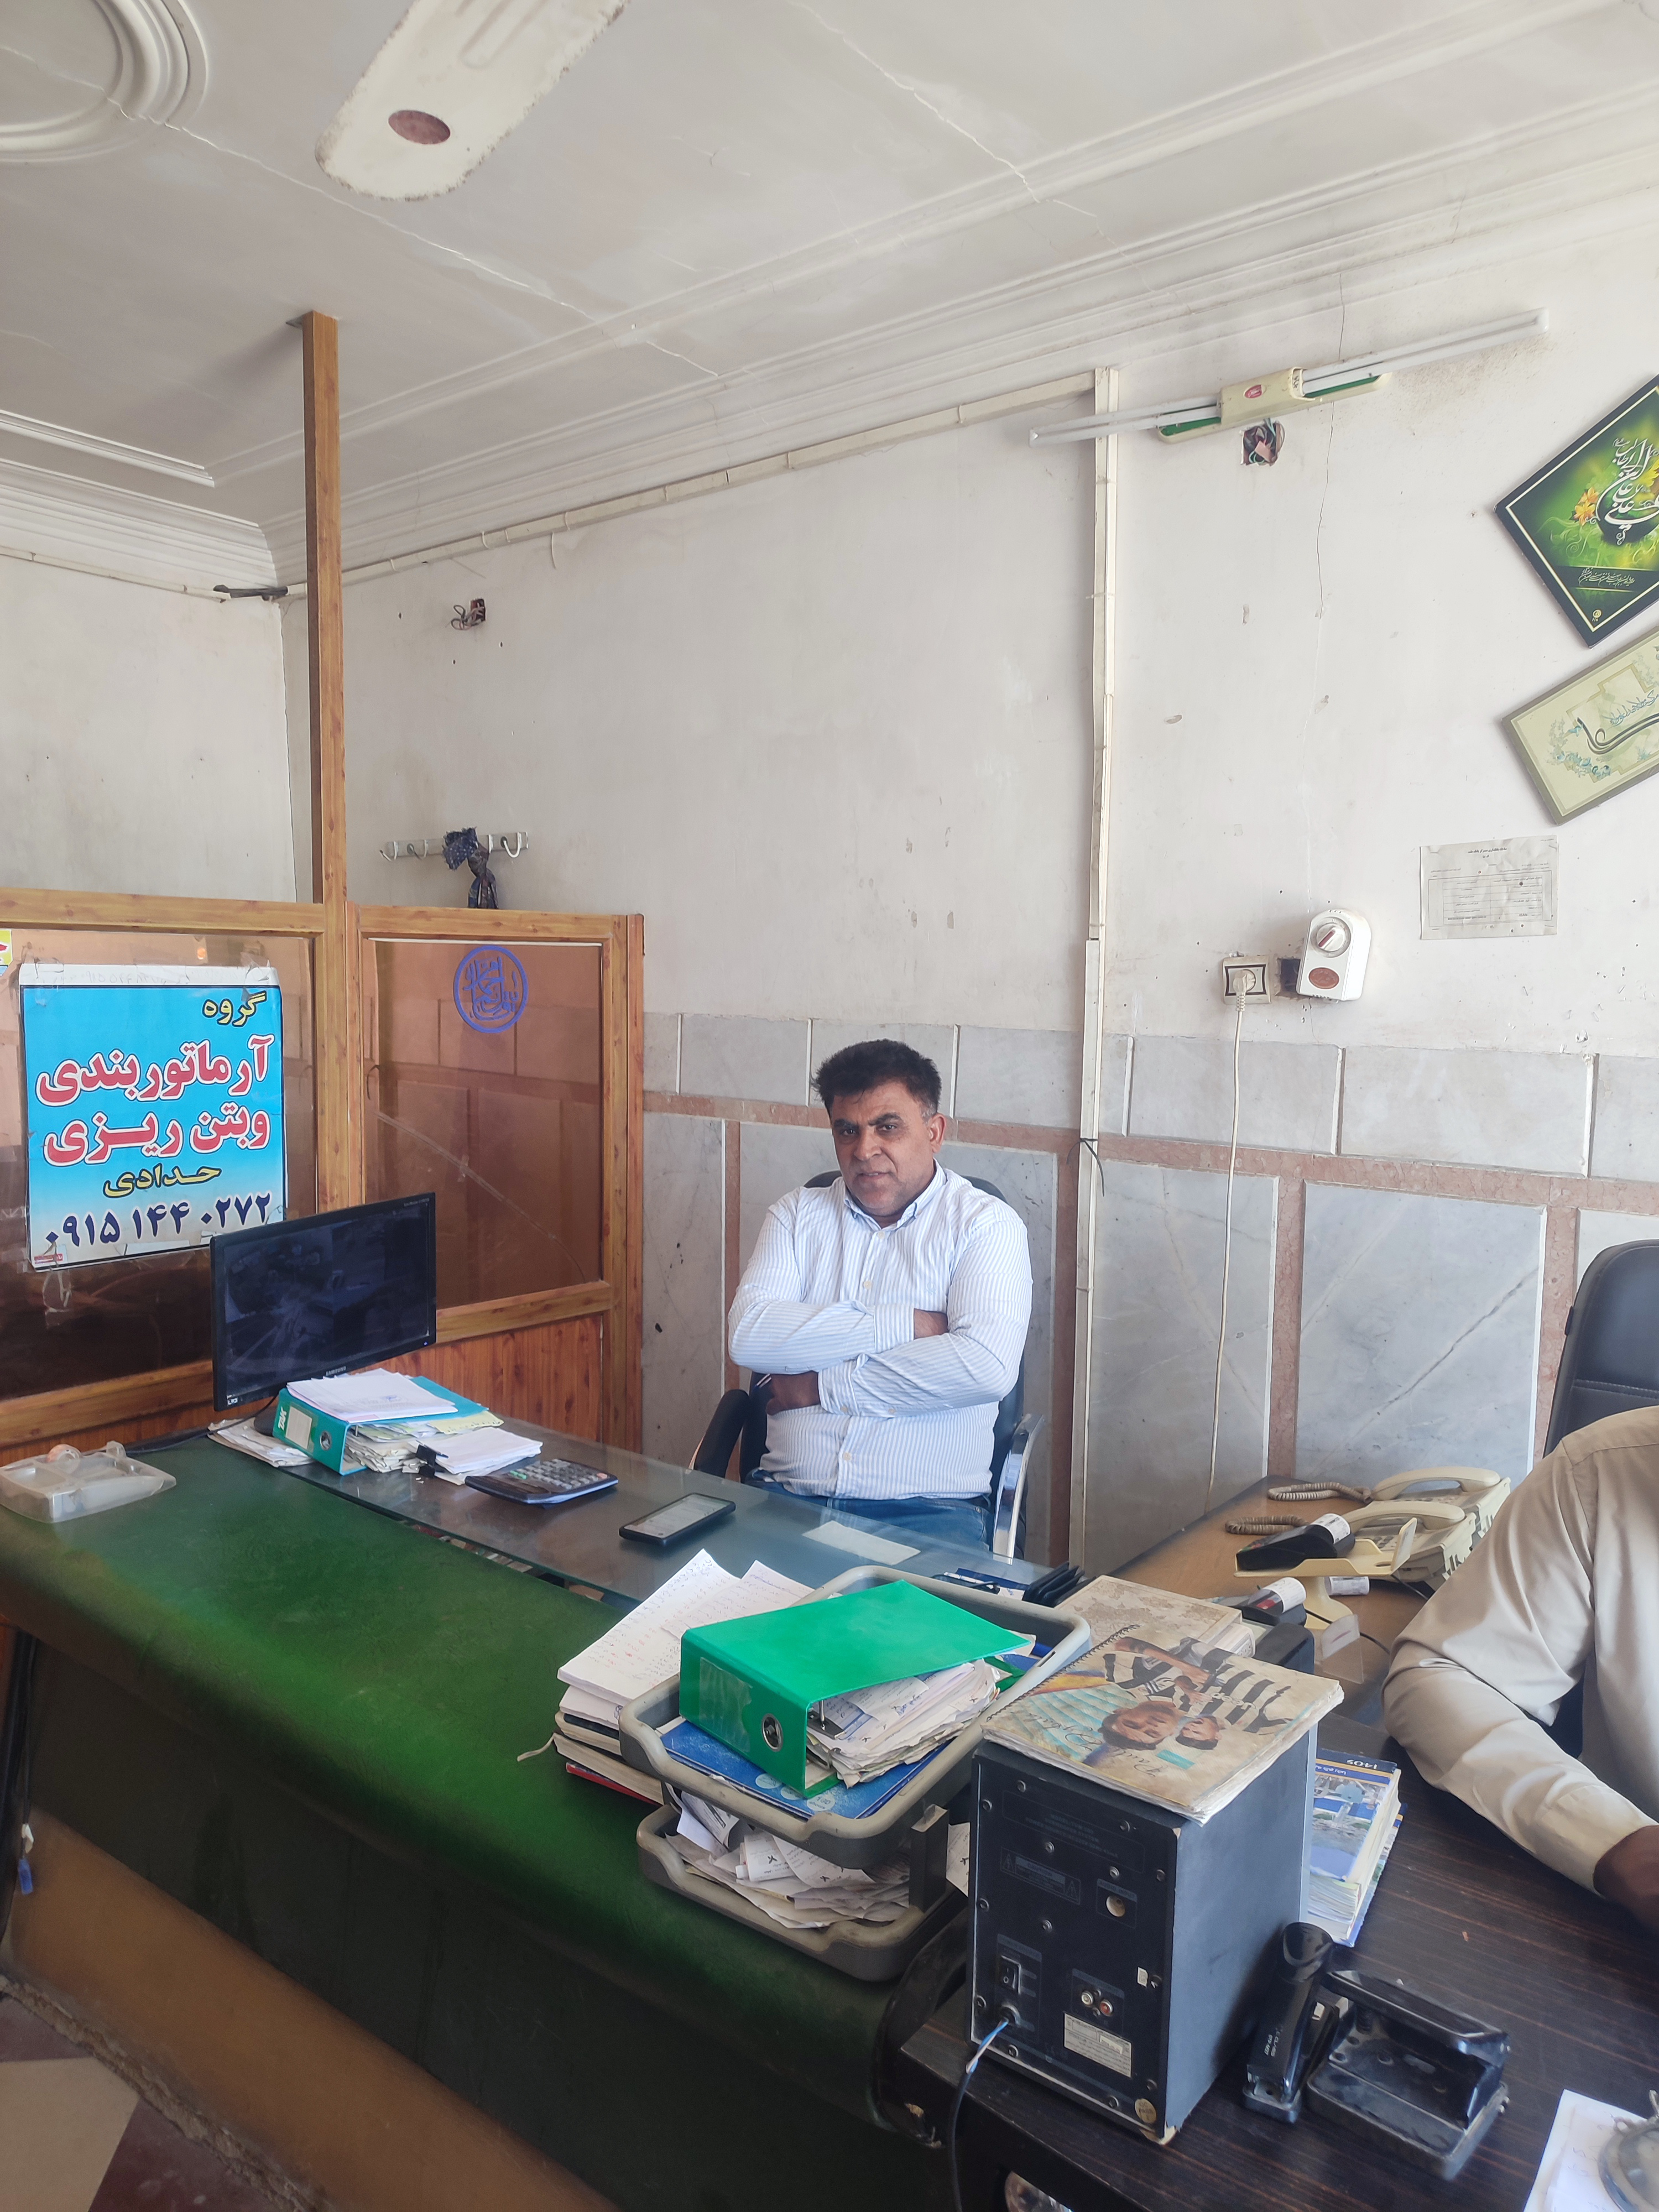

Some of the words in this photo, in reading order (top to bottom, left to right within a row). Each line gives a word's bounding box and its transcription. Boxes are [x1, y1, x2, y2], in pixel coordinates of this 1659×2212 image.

[202, 991, 267, 1025] گروه
[103, 1164, 222, 1198] حدادی
[277, 1406, 288, 1431] TAK
[1210, 1691, 1257, 1713] Jeep
